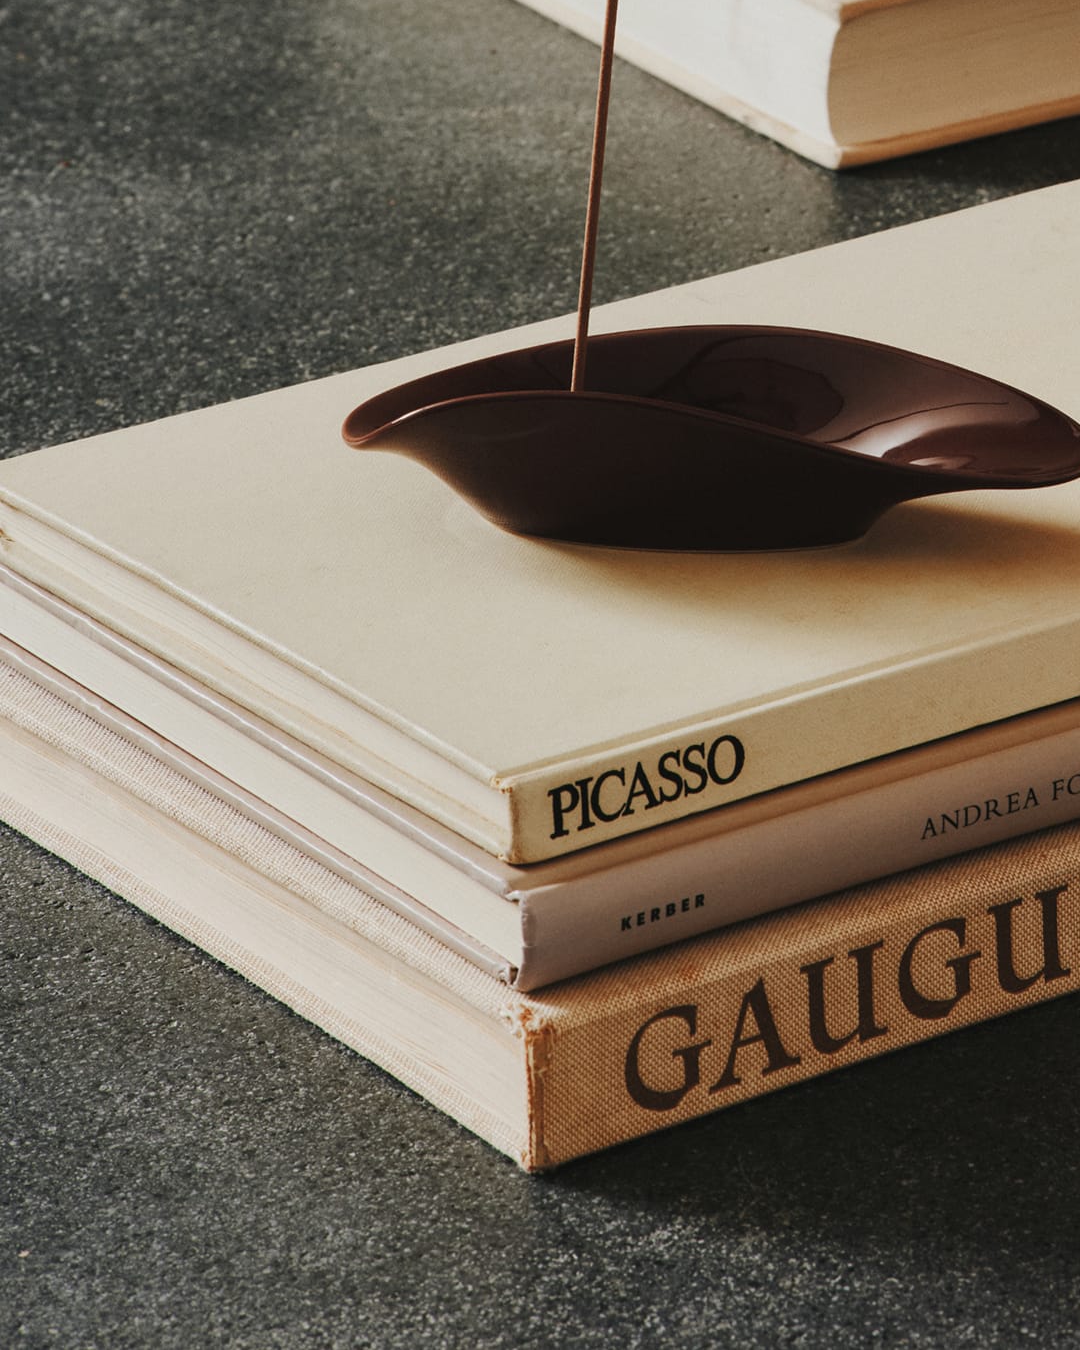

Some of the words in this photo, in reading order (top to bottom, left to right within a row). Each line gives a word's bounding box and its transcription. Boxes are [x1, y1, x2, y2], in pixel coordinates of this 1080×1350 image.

[548, 734, 745, 839] PICASSO
[921, 787, 1040, 840] ANDREA
[620, 893, 706, 932] KERBER
